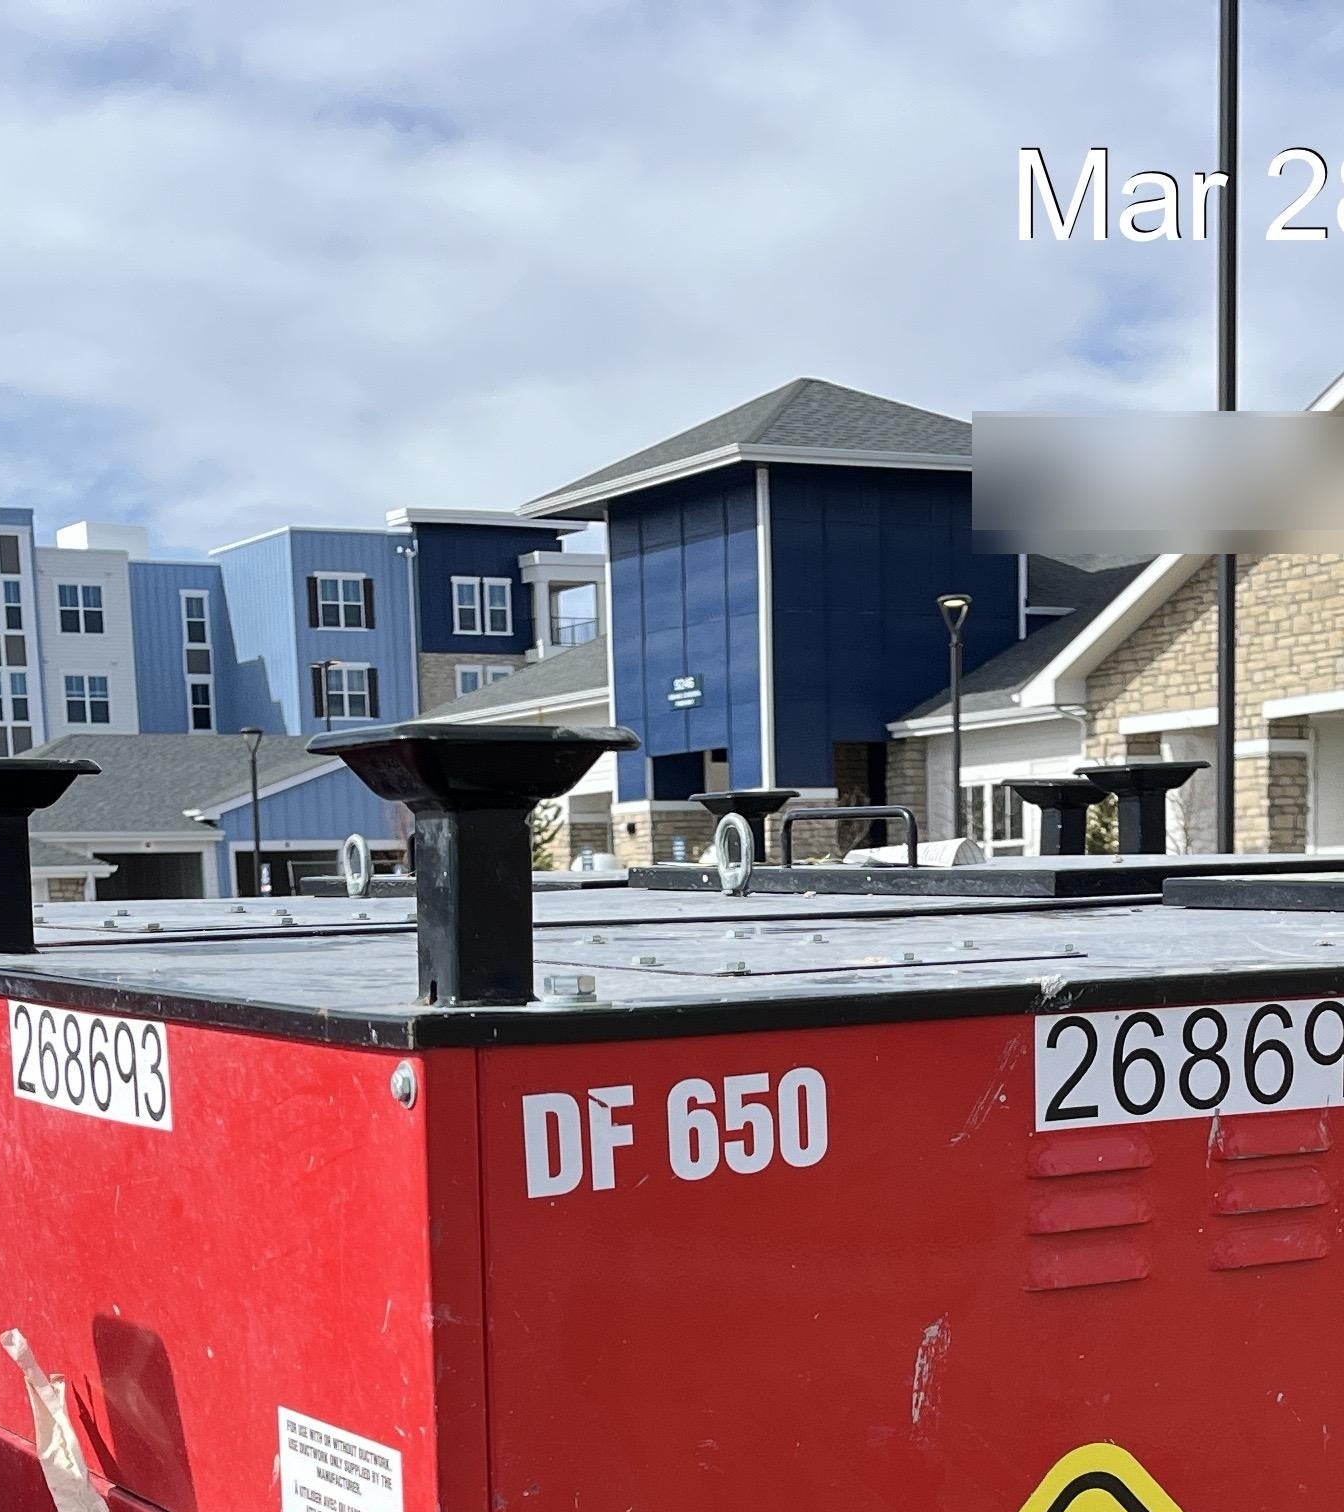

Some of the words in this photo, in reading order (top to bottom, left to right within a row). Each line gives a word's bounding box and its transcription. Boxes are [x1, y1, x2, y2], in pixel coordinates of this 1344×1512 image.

[14, 1004, 168, 1122] 268693
[522, 1084, 635, 1199] DF
[667, 1066, 829, 1182] 650
